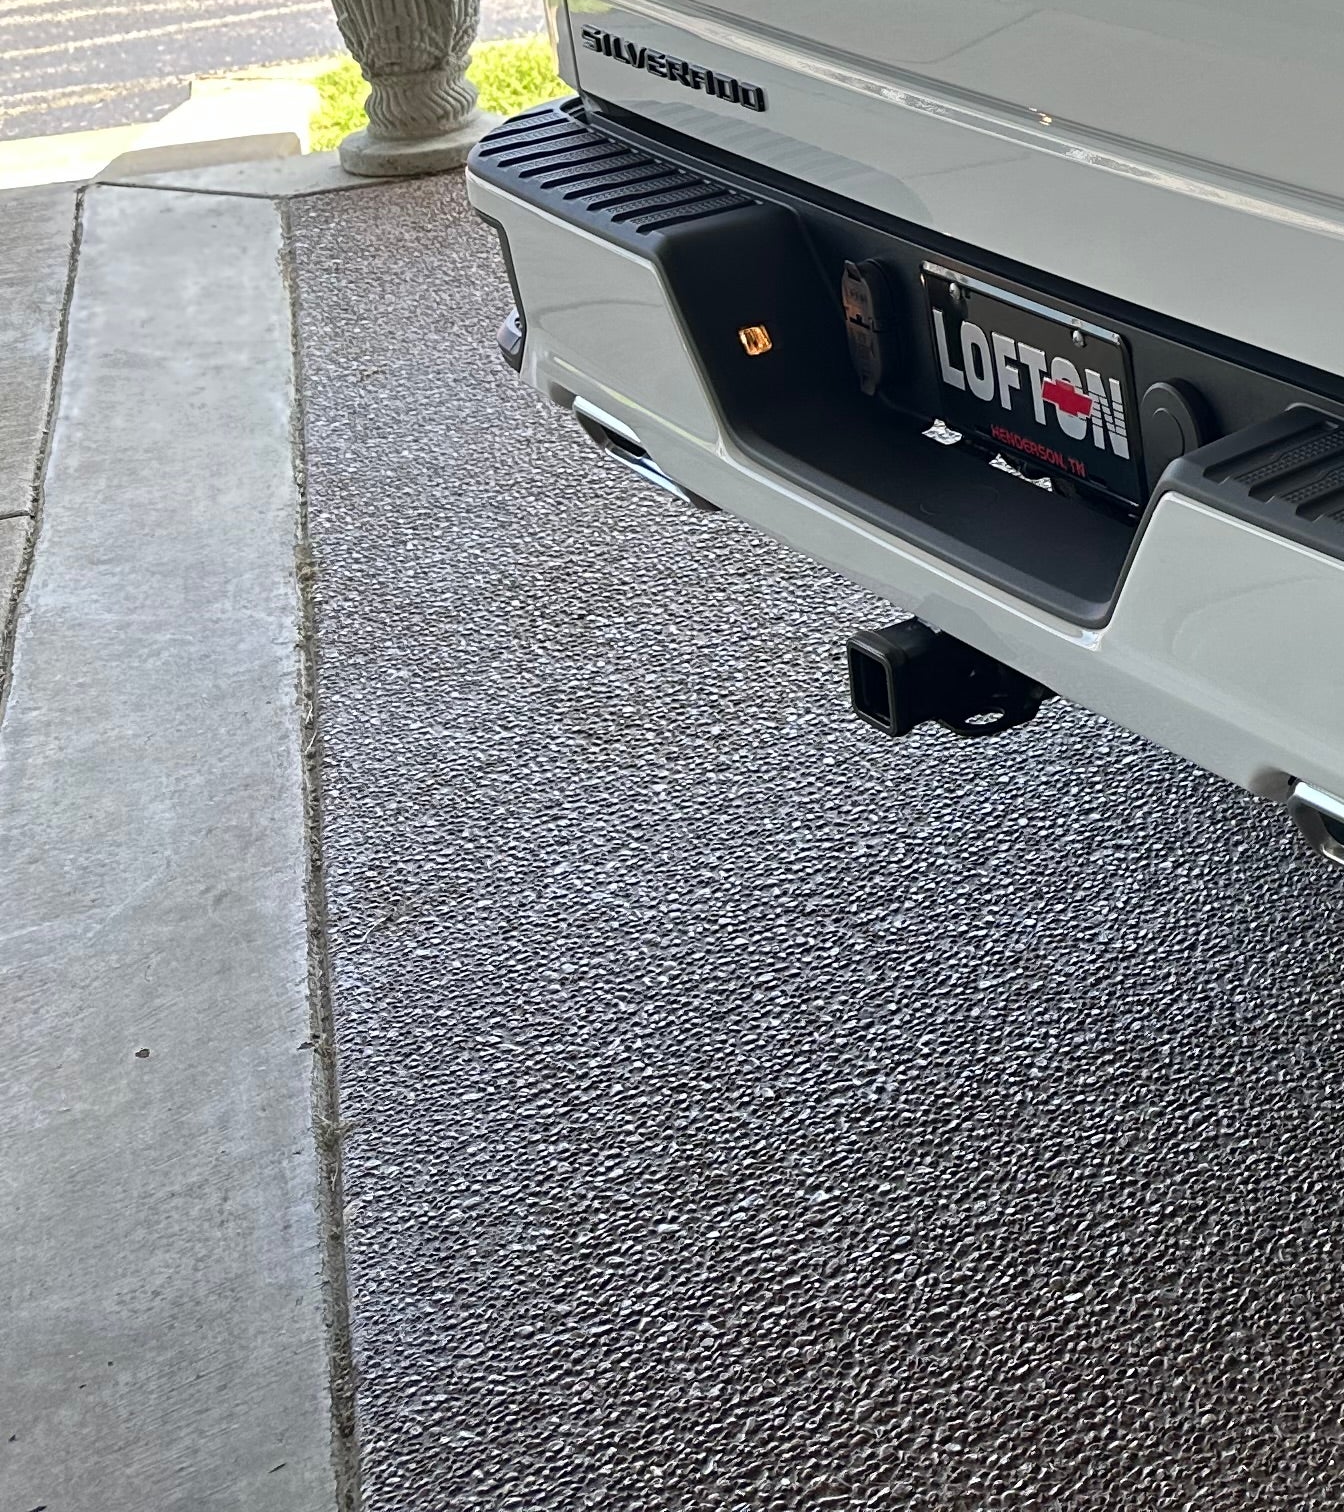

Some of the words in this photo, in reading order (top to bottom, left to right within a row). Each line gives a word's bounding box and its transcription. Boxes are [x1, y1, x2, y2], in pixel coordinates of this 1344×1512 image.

[581, 24, 767, 112] SILVERADO
[933, 308, 1130, 460] LOFTON
[1069, 458, 1087, 478] TN
